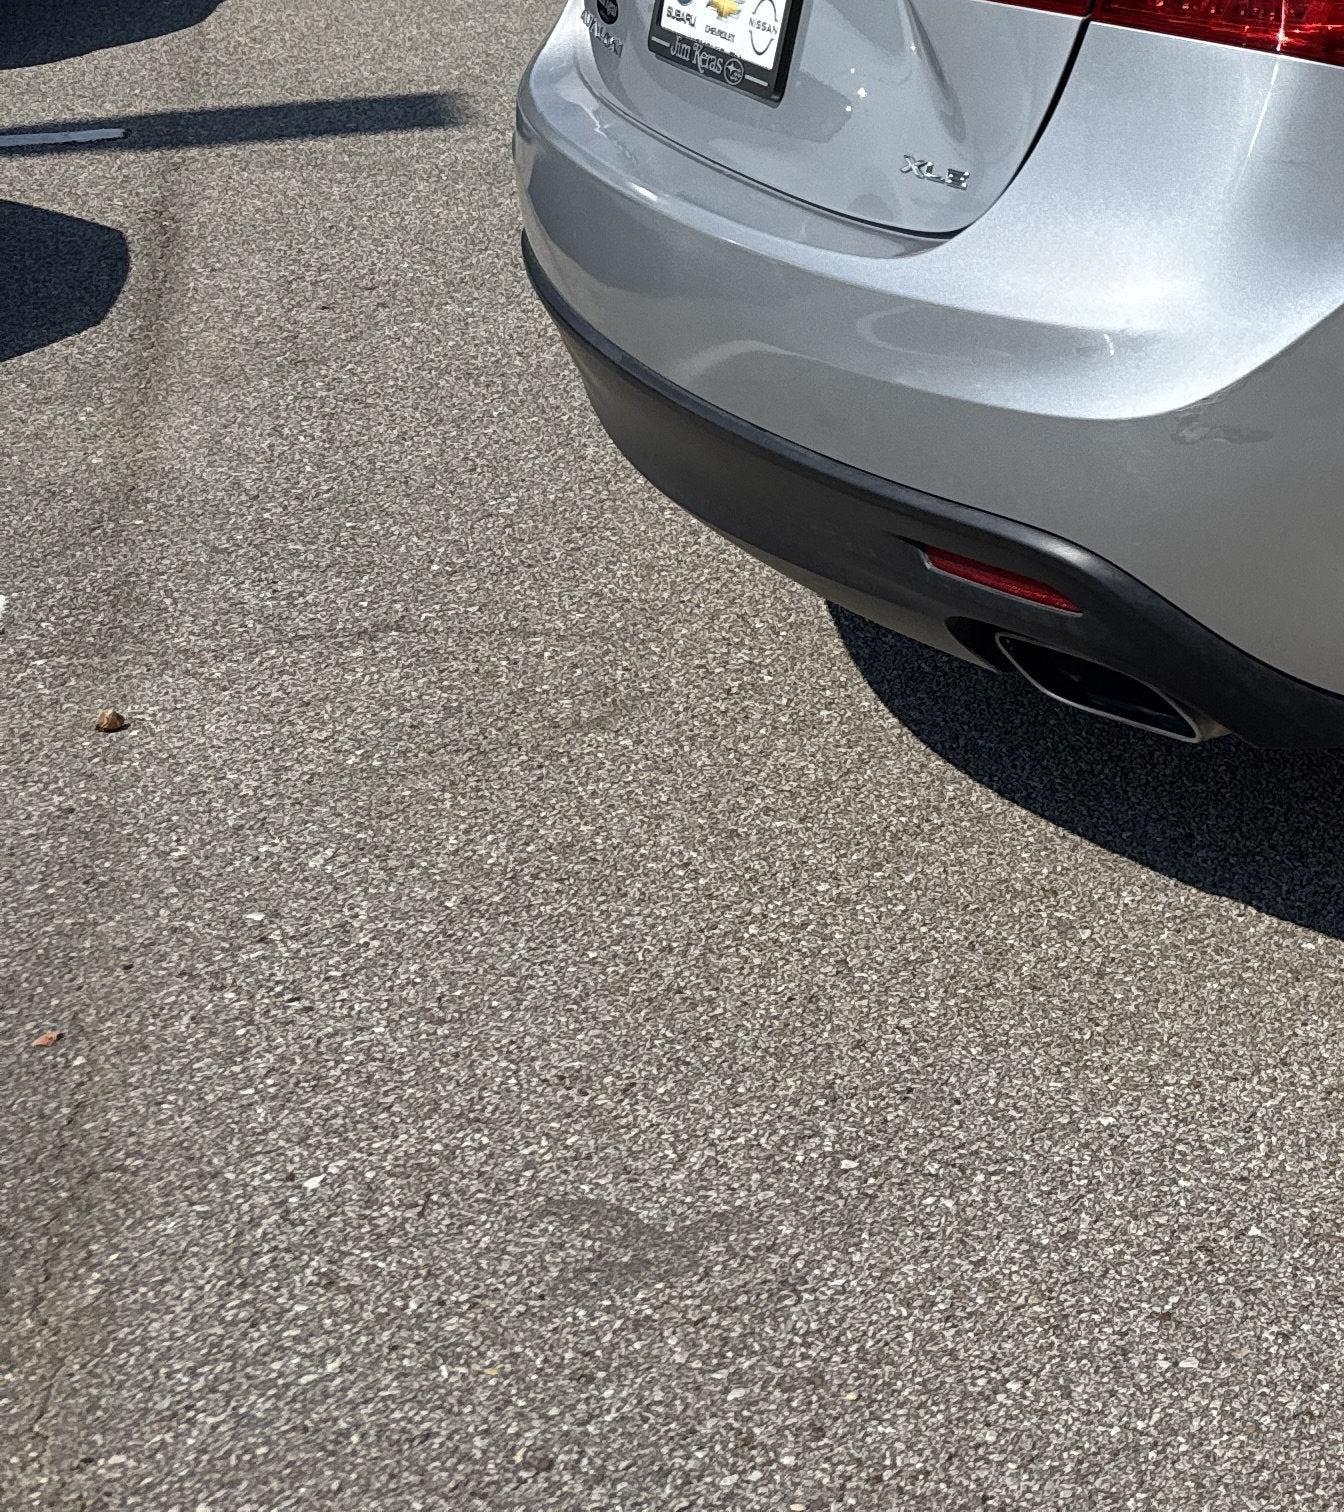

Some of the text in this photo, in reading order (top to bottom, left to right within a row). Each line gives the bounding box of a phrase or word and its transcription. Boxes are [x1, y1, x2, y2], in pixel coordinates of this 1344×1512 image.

[666, 5, 697, 29] SUBARU
[748, 17, 779, 36] NISSAN
[670, 35, 691, 61] Jim
[691, 42, 724, 74] Keras
[899, 152, 971, 192] XLE
